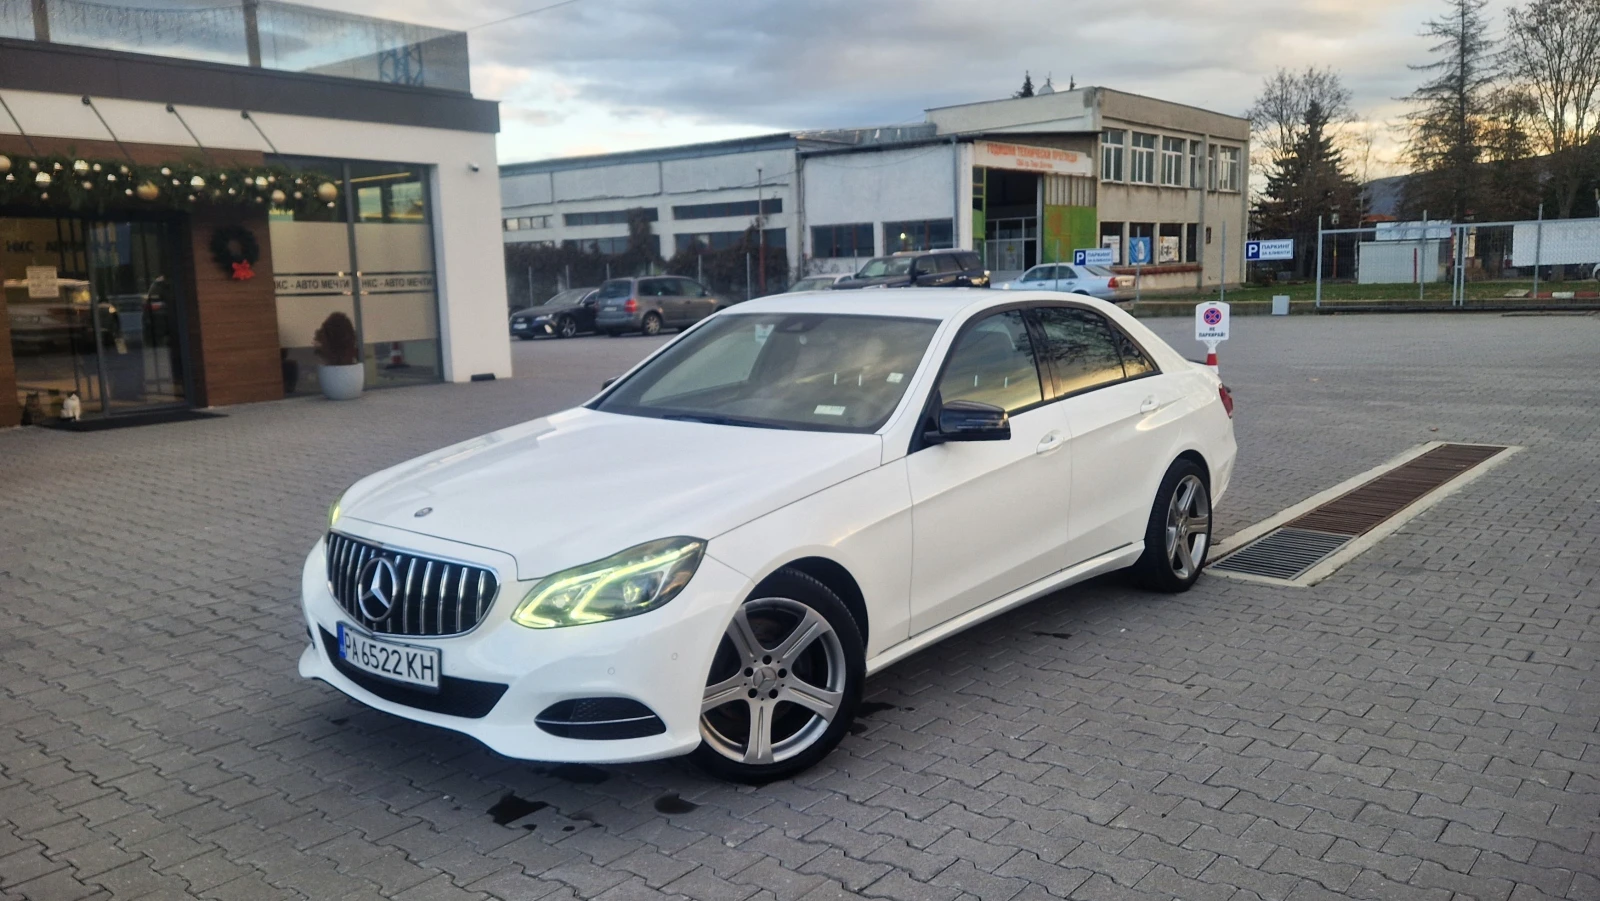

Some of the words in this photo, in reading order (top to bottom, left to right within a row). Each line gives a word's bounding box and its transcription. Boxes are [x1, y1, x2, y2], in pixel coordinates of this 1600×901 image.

[295, 279, 319, 289] АВТО
[321, 279, 350, 289] МЕЧТИ
[362, 279, 378, 288] НКС
[384, 278, 405, 288] АВТО
[407, 277, 433, 287] МЕЧТИ
